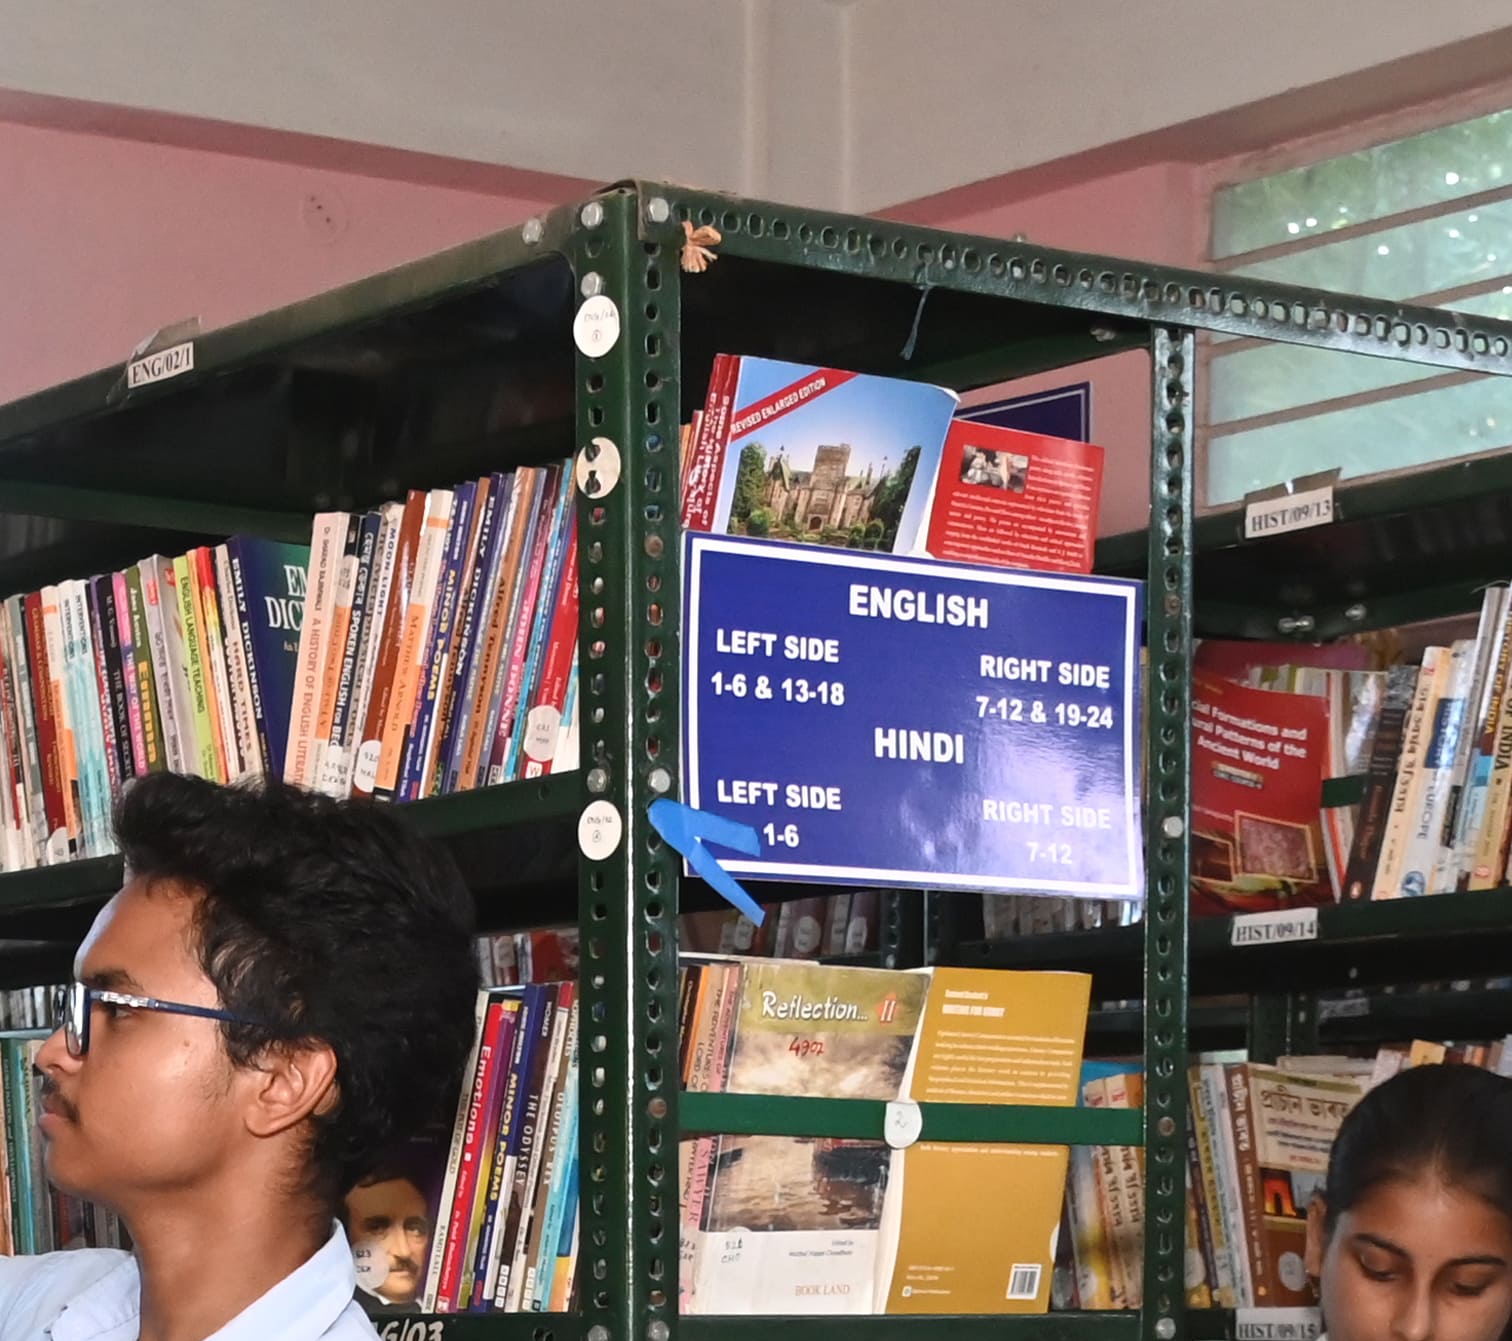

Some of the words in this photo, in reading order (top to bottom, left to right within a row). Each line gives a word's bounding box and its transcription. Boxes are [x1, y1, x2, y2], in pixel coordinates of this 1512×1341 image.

[730, 412, 761, 434] REVISED
[761, 392, 798, 416] ENLARGED
[799, 377, 825, 398] EDITION
[850, 585, 988, 628] ENGLISH
[232, 558, 247, 613] EMILY
[240, 620, 262, 720] DICKINSON
[717, 629, 777, 656] LEFT
[784, 636, 838, 662] SIDE
[981, 655, 1051, 682] RIGHT
[1059, 662, 1109, 688] SIDE
[712, 672, 746, 697] 1-6
[755, 676, 772, 699] &
[782, 678, 844, 705] 13-18
[976, 696, 1023, 721] 7-12
[1030, 701, 1046, 723] &
[1055, 703, 1113, 728] 19-24
[1212, 706, 1279, 736] Formations
[1281, 728, 1307, 740] and
[875, 728, 963, 763] HINDI
[1198, 735, 1240, 759] Ancient
[1241, 750, 1279, 769] World
[1215, 725, 1266, 750] Patterns
[1267, 741, 1281, 752] of
[1283, 743, 1306, 758] the
[718, 780, 778, 805] LEFT
[786, 785, 841, 810] SIDE
[983, 800, 1053, 825] RIGHT
[1061, 804, 1111, 828] SIDE
[764, 823, 799, 847] 1-6
[1026, 842, 1072, 864] 7-12
[880, 1000, 896, 1021] II
[501, 1073, 517, 1135] MINOR
[490, 1139, 507, 1202] POEMS
[795, 1284, 820, 1296] BOOK
[823, 1283, 850, 1295] LAND
